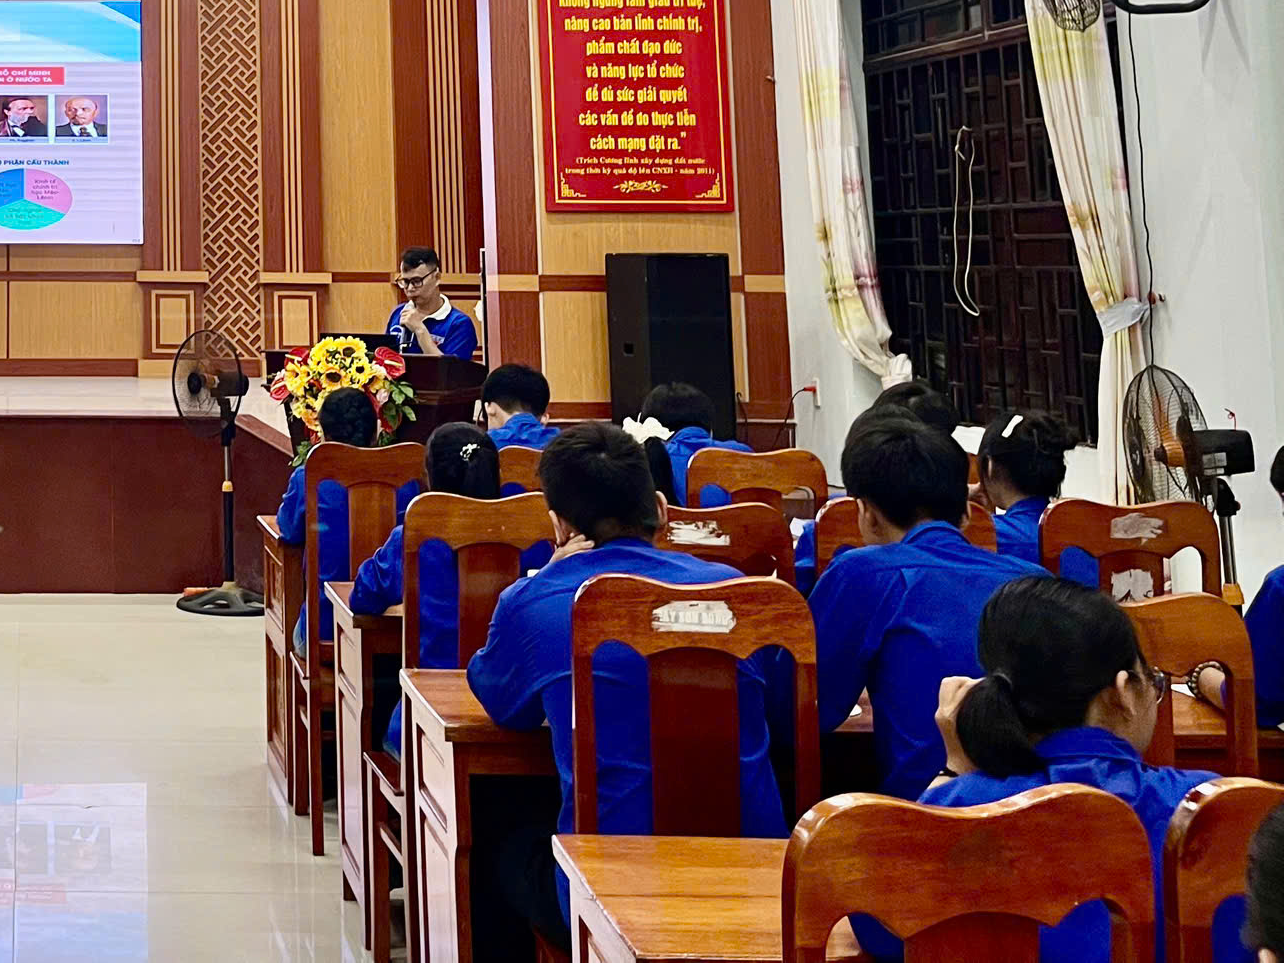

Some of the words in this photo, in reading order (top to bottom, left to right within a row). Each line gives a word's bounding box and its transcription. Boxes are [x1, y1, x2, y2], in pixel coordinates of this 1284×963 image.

[564, 16, 589, 32] nâng
[592, 18, 611, 31] cao
[613, 14, 632, 31] bản
[657, 13, 685, 31] chính
[617, 37, 640, 55] chất
[642, 40, 661, 57] đạo
[663, 38, 683, 55] đức
[586, 63, 598, 78] và
[600, 62, 626, 80] năng
[628, 63, 645, 81] lực
[660, 62, 685, 78] chức
[616, 86, 634, 102] sức
[637, 85, 657, 104] giải
[659, 85, 688, 104] quyết
[578, 110, 598, 126] các
[636, 112, 649, 126] do
[651, 111, 674, 129] thực
[590, 134, 615, 150] cách
[617, 137, 646, 153] mạng
[649, 135, 665, 153] đặt
